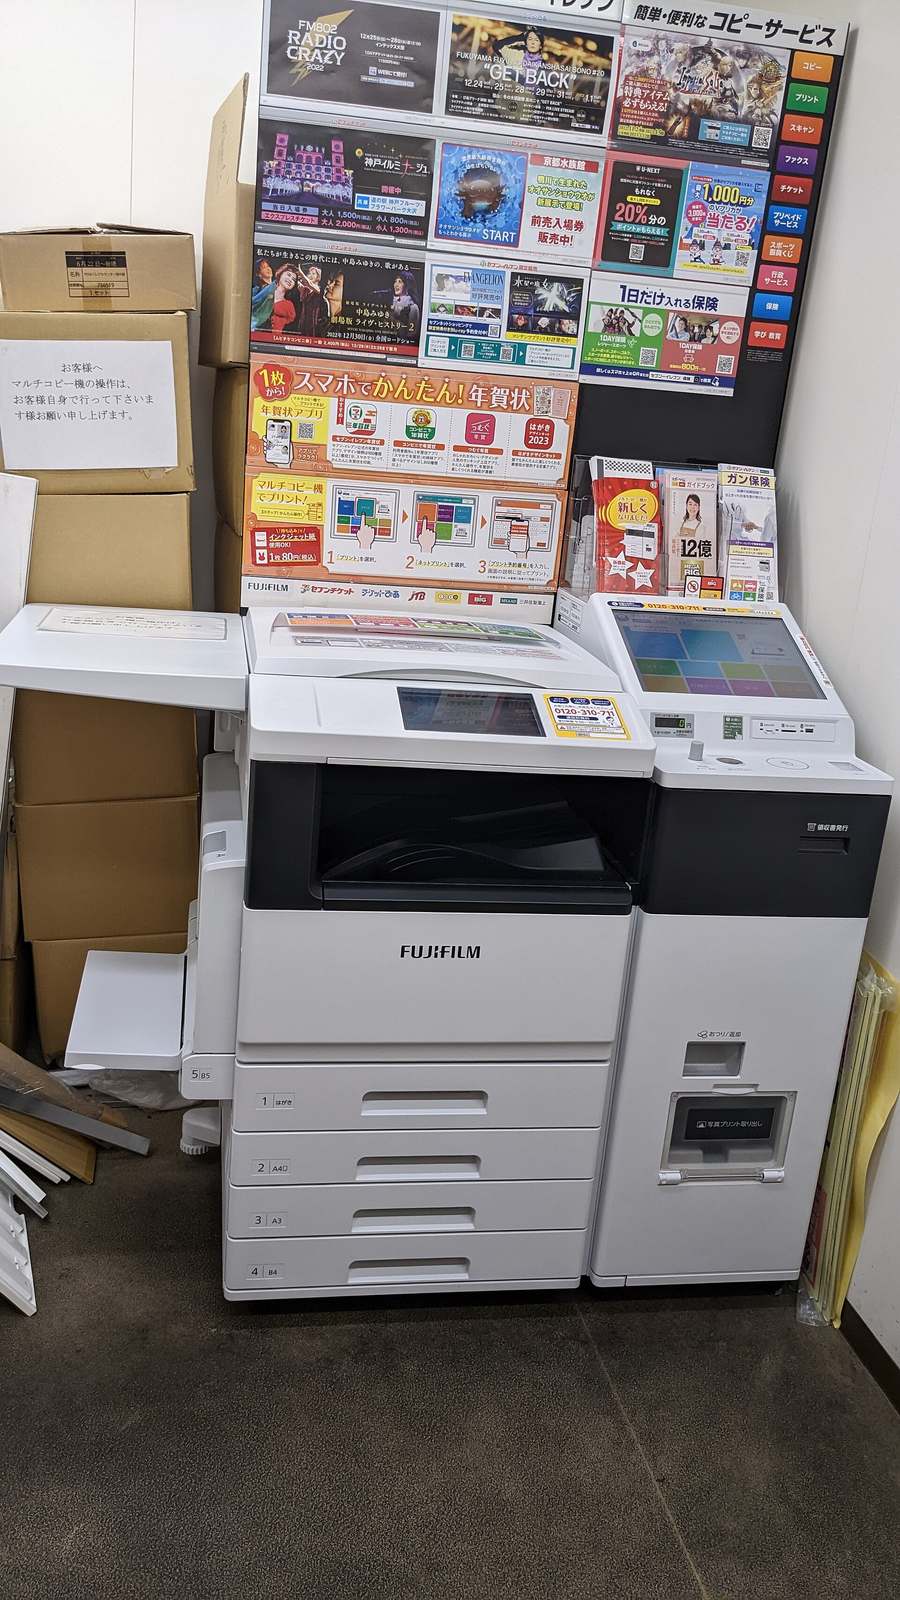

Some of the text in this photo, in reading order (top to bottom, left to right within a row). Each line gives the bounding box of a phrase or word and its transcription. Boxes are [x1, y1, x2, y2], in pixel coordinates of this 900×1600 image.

[298, 20, 337, 35] FM802
[633, 4, 837, 48] 簡単・便利な コピーサービス
[287, 29, 347, 51] RADIO
[286, 45, 346, 66] CRAZY
[456, 52, 492, 62] FUKUYAMA
[306, 63, 324, 72] 2022
[802, 62, 824, 72] コピー
[464, 79, 483, 88] 12.24
[624, 85, 670, 102] 特典アイテム
[794, 92, 820, 104] プリント
[789, 123, 816, 134] スキャン
[543, 157, 586, 170] 京都水族館
[784, 154, 810, 166] ファックス
[364, 157, 429, 177] 神戸イルミナージュ
[641, 167, 660, 175] U-NEXT
[381, 185, 402, 194] 開催中
[528, 185, 595, 201] オオサンショウウオが
[634, 188, 656, 197] もれなく
[703, 183, 754, 206] 1,000円分
[780, 185, 804, 194] チケット
[322, 210, 334, 218] 大人
[376, 215, 388, 223] 小人
[614, 203, 666, 225] 20% 分の
[773, 212, 802, 221] プリペイド
[264, 213, 316, 224] エクスプレスチケット
[321, 218, 334, 227] 大人
[375, 224, 388, 232] 小人
[531, 215, 585, 232] 前売入場券
[707, 212, 756, 232] 当たる!
[774, 219, 799, 229] サービス
[482, 229, 517, 243] START
[538, 232, 574, 246] 販売中!
[770, 241, 795, 251] スポーツ
[464, 272, 504, 286] EVANGELION
[771, 271, 785, 279] 行政
[764, 277, 788, 287] サービス
[619, 284, 720, 313] 1日だけ入れる保険
[356, 308, 390, 319] 中島みゆき
[408, 323, 415, 331] 2
[375, 335, 415, 344] 全国ロードショー
[754, 331, 767, 339] 学び
[61, 362, 104, 373] お客様へ
[259, 366, 286, 388] 1枚
[11, 378, 132, 390] マルチコピー機の操作は、
[266, 386, 286, 396] から!
[294, 371, 531, 411] スマホでかんたん! 年賀状
[13, 394, 155, 405] お客様自身で行って下さいま
[15, 409, 134, 421] す様お願い申し上げます。
[260, 404, 324, 419] 年賀状アプリ
[529, 423, 550, 432] はがき
[528, 436, 549, 445] 2023
[727, 473, 771, 488] ガン保険
[256, 480, 323, 494] マルチコピー機
[258, 494, 307, 505] でプリント!
[618, 502, 647, 514] 新しく
[269, 533, 316, 542] インクジェット紙
[680, 539, 713, 558] 12億
[327, 550, 334, 564] 1
[405, 556, 415, 569] 2
[478, 560, 487, 574] 3
[248, 582, 289, 592] FUJIFILM
[311, 585, 355, 596] セブンチケット
[408, 592, 426, 602] JTB
[648, 603, 700, 611] 0120-310-711
[554, 708, 615, 717] 0120-310-711
[400, 945, 481, 959] FUJIFILM
[192, 1069, 198, 1079] 5
[262, 1097, 267, 1106] 1
[258, 1163, 265, 1173] 2
[255, 1216, 262, 1225] 3
[251, 1268, 258, 1276] 4
